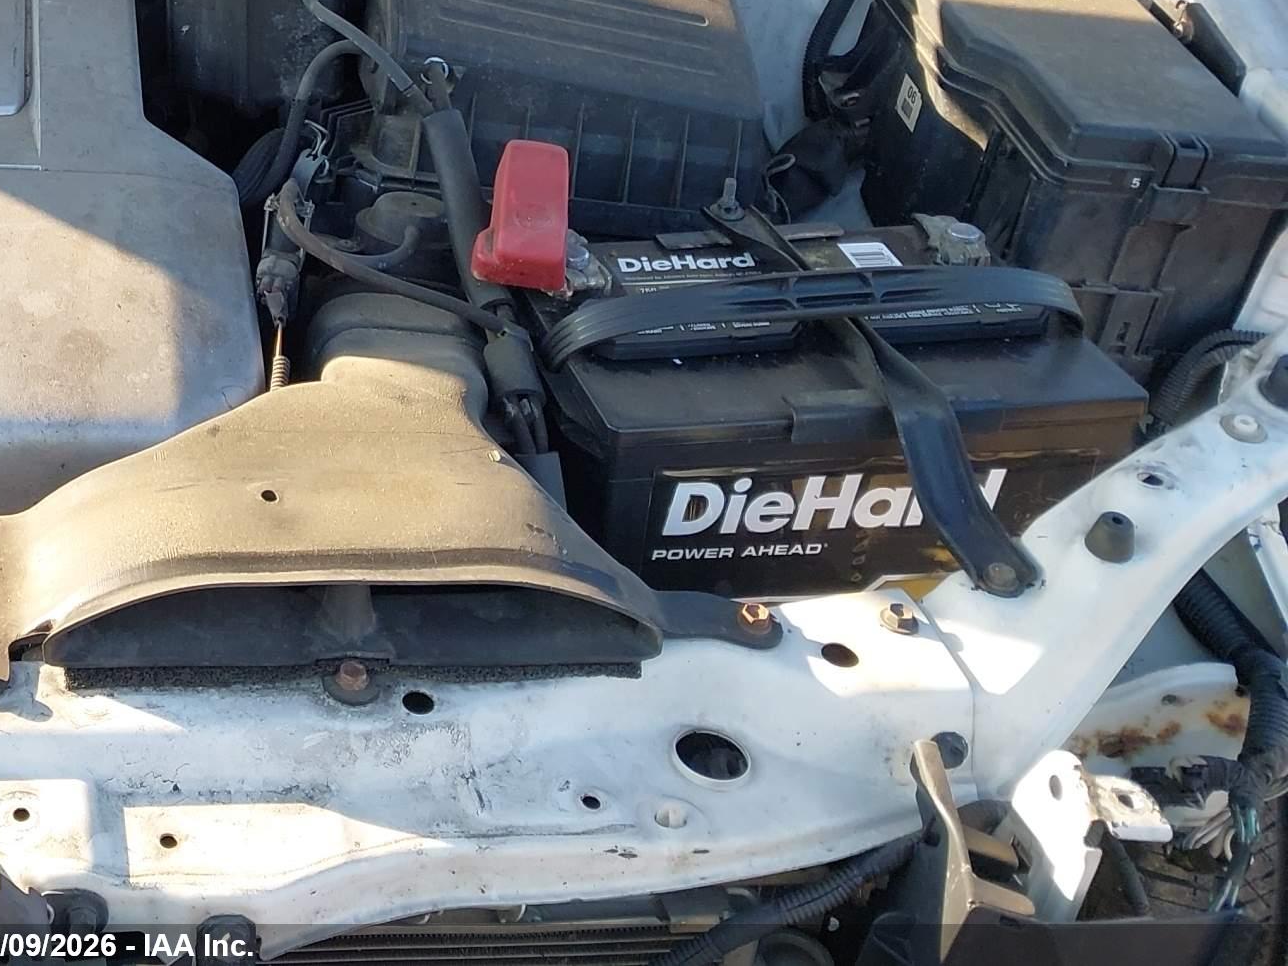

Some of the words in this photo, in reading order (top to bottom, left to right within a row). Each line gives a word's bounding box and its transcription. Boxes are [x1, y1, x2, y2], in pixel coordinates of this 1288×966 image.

[1130, 177, 1141, 188] 5
[617, 252, 756, 273] DieHard
[651, 547, 734, 561] POWER
[740, 543, 822, 558] AHEAD
